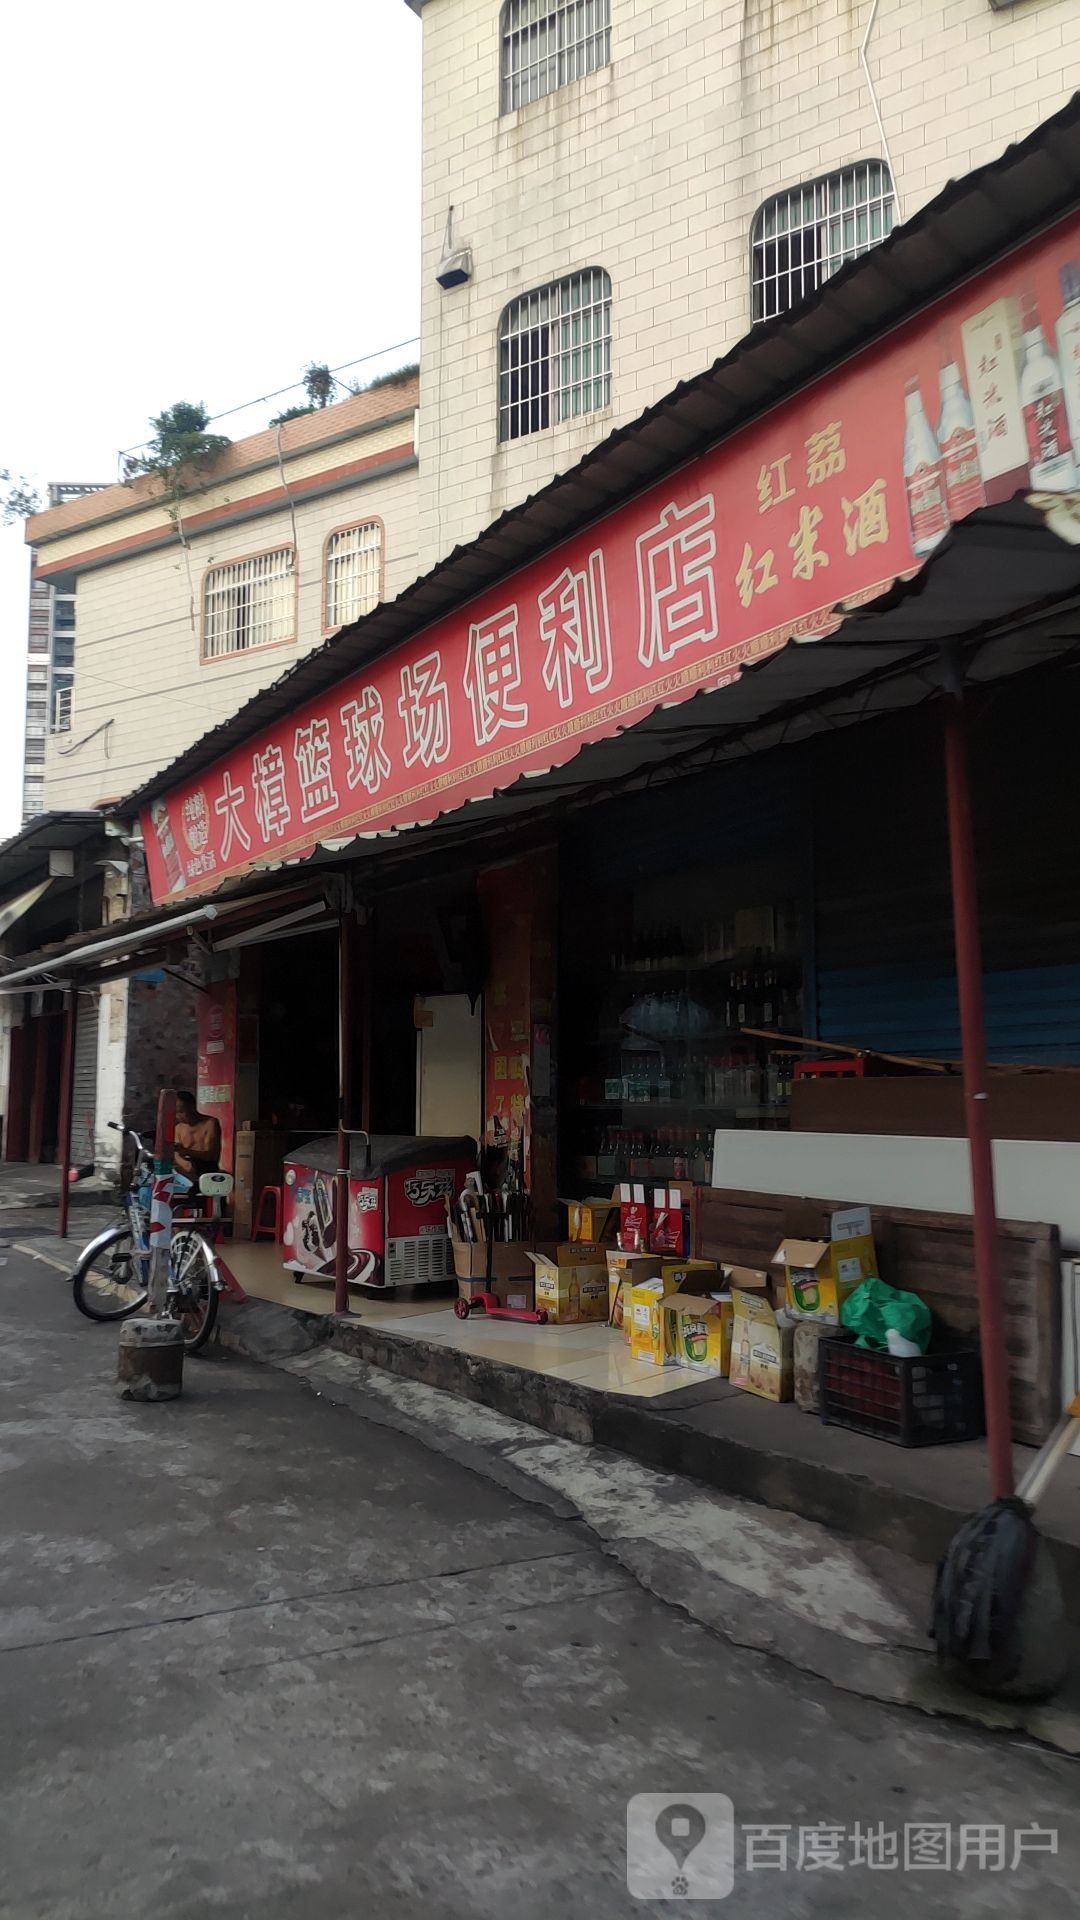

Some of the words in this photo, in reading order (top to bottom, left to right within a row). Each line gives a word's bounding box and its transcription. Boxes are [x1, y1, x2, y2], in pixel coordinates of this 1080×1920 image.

[755, 420, 847, 514] 红荔
[735, 477, 890, 609] 红米酒
[215, 493, 720, 862] 大樟篮球场便利店
